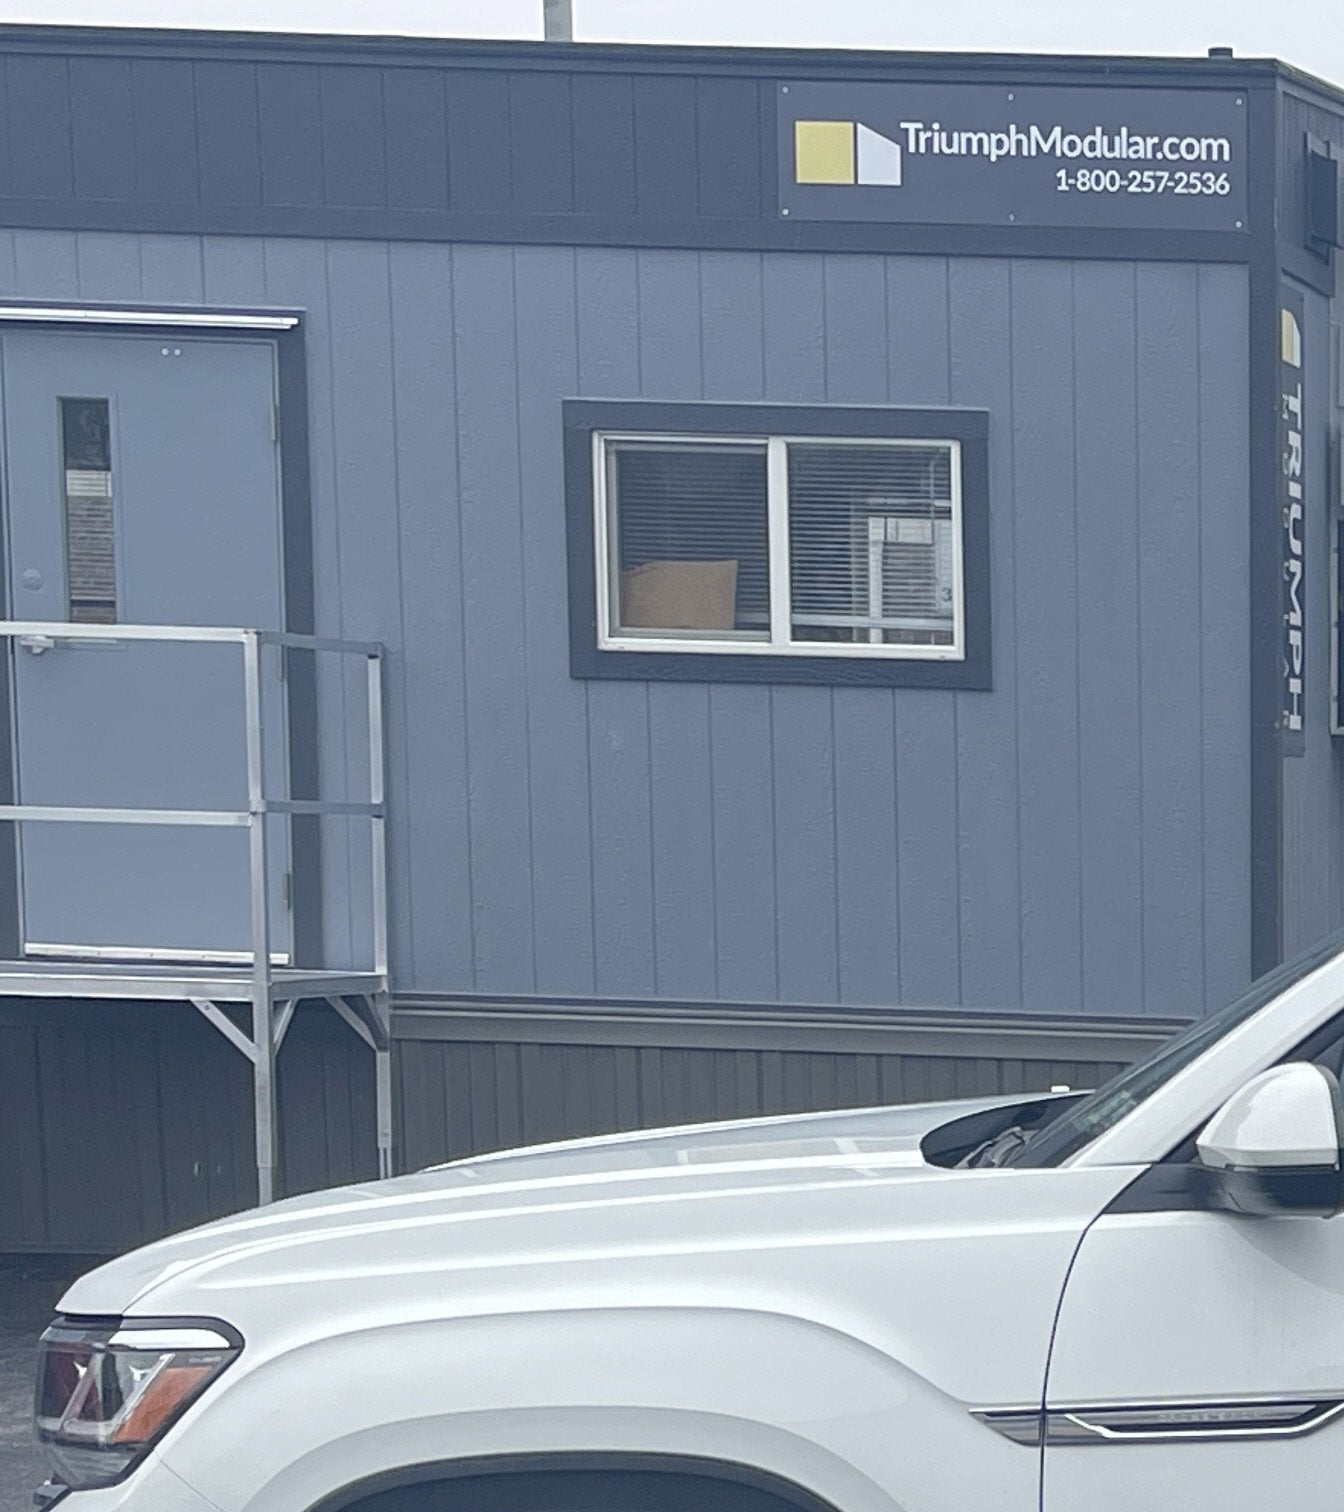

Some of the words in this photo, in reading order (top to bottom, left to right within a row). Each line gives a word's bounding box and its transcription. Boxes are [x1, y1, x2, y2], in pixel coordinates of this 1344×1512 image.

[899, 122, 1231, 163] TriumphModular.com
[1055, 168, 1231, 196] 1-800-257-2536
[1288, 382, 1302, 731] TRIUMPH
